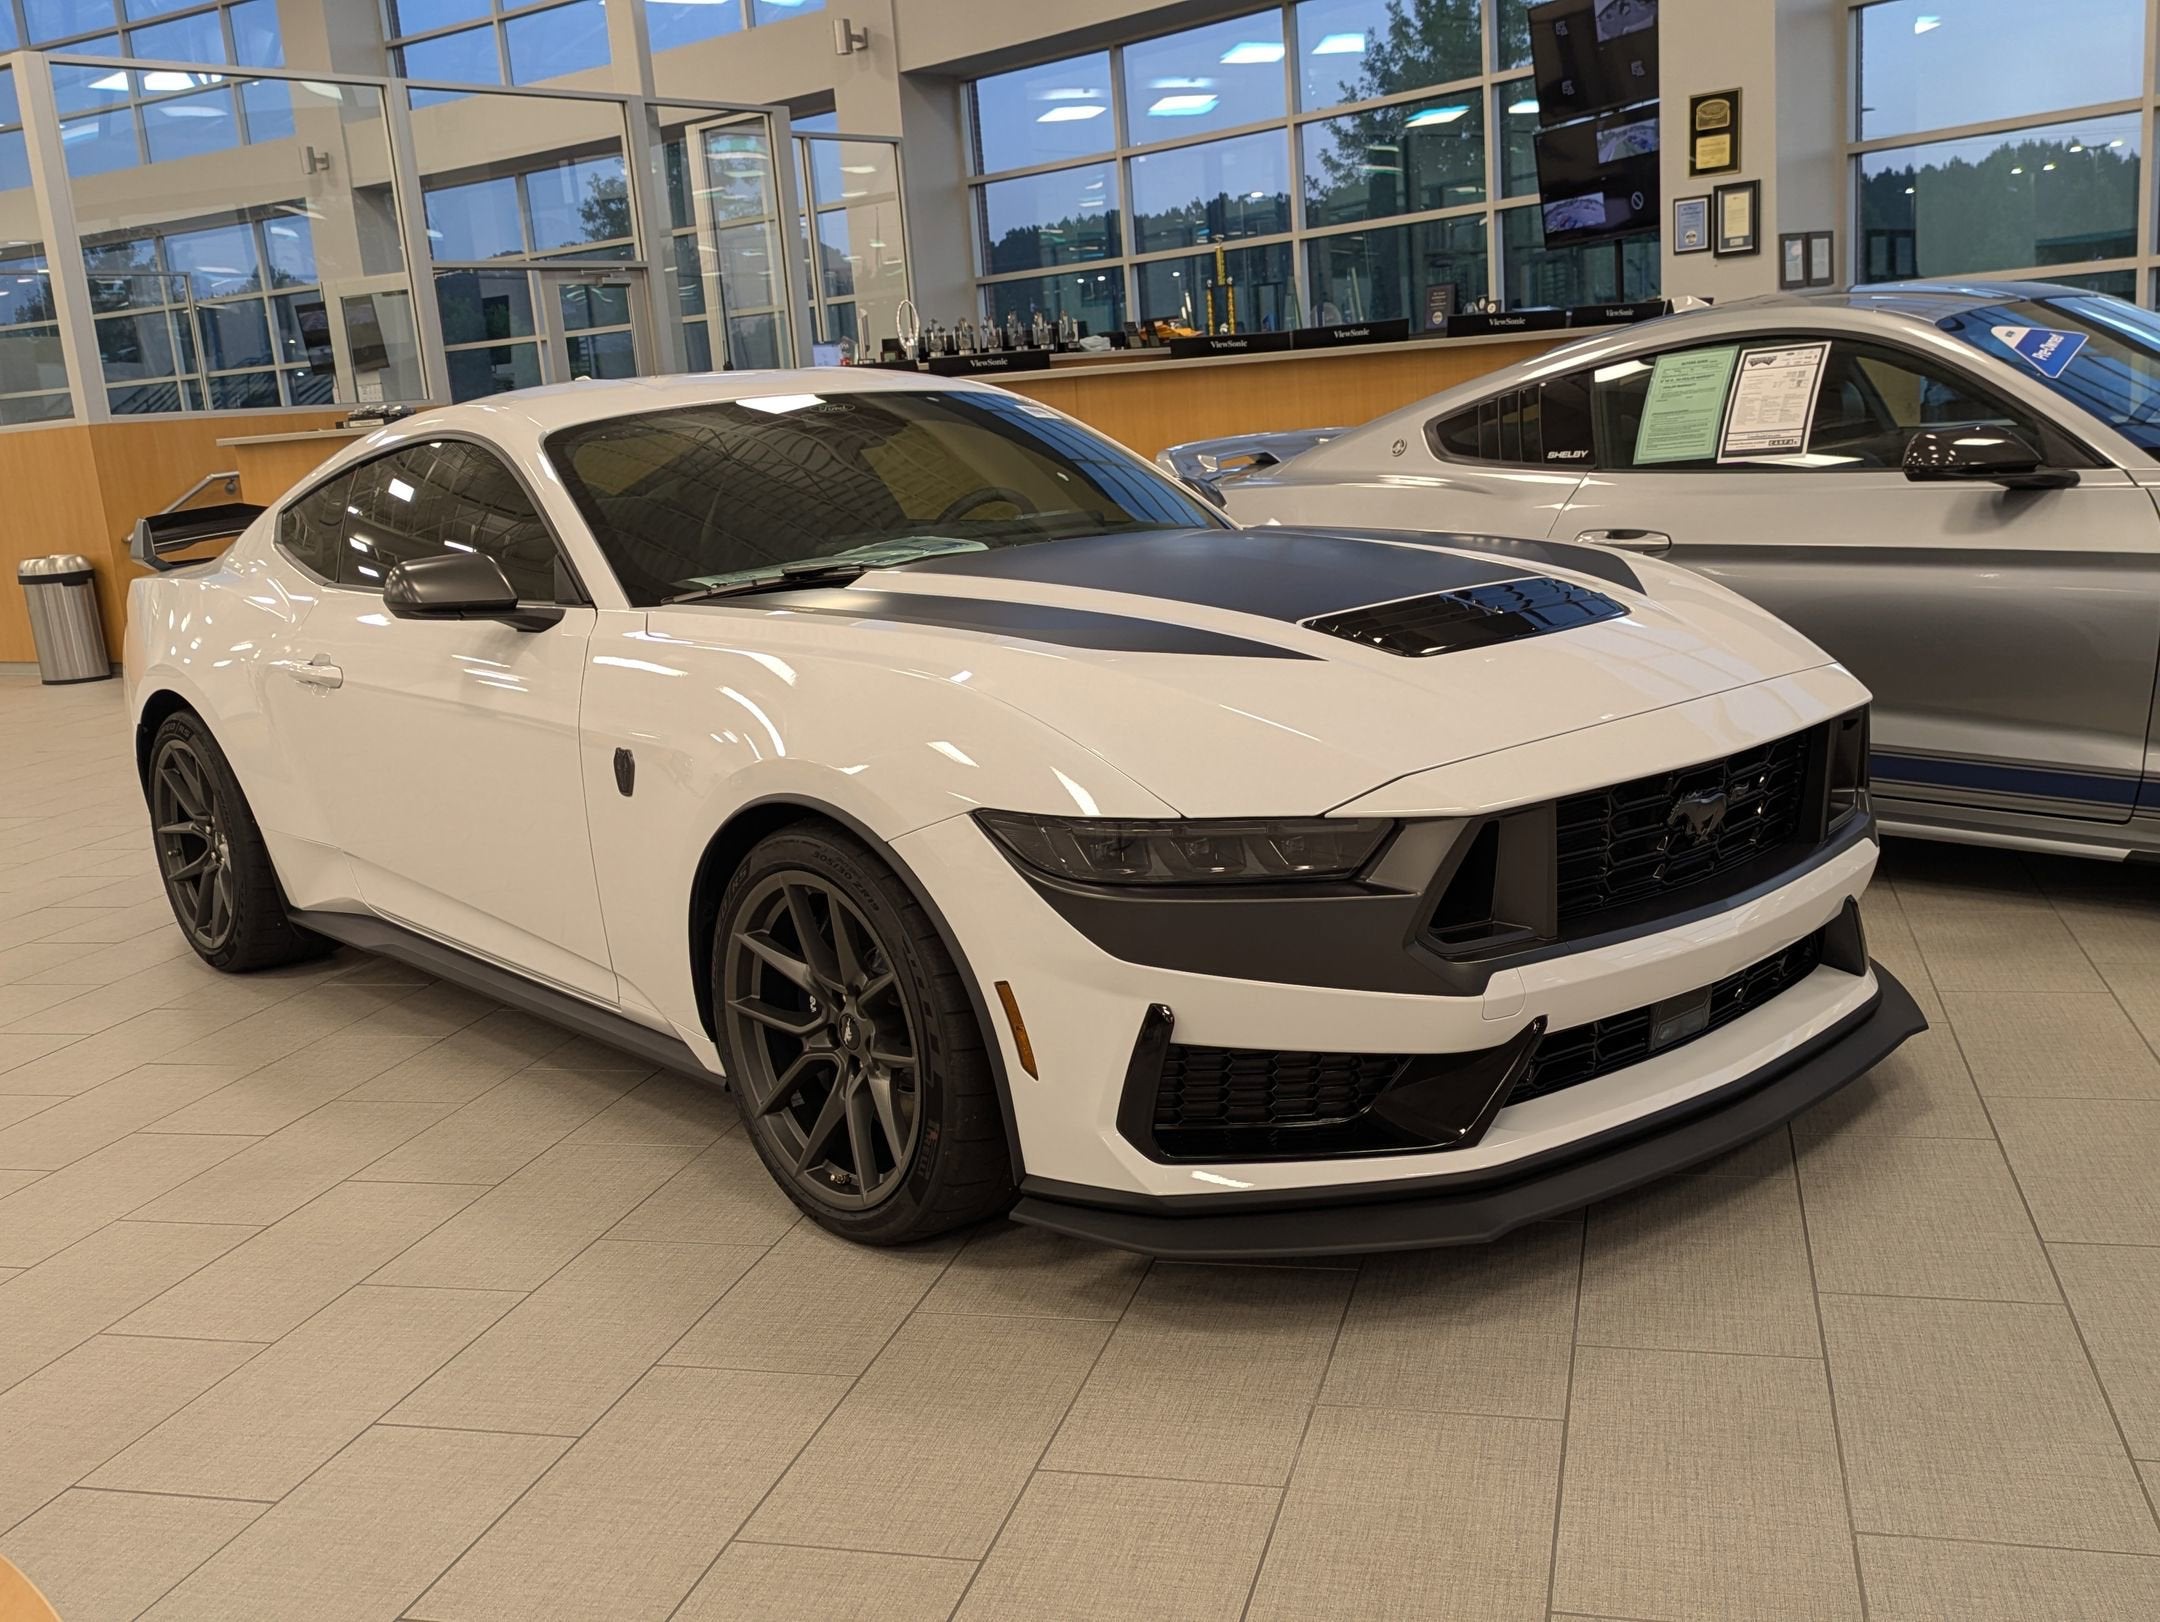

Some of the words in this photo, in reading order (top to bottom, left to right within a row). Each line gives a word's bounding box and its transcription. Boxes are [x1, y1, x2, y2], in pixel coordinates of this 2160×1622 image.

[1488, 316, 1526, 327] ViewSonic
[1333, 327, 1371, 339] ViewSonic
[1209, 339, 1248, 350] ViewSonic
[969, 357, 1008, 368] ViewSonic
[1547, 449, 1589, 459] SHELBY
[811, 850, 852, 880] 305/30
